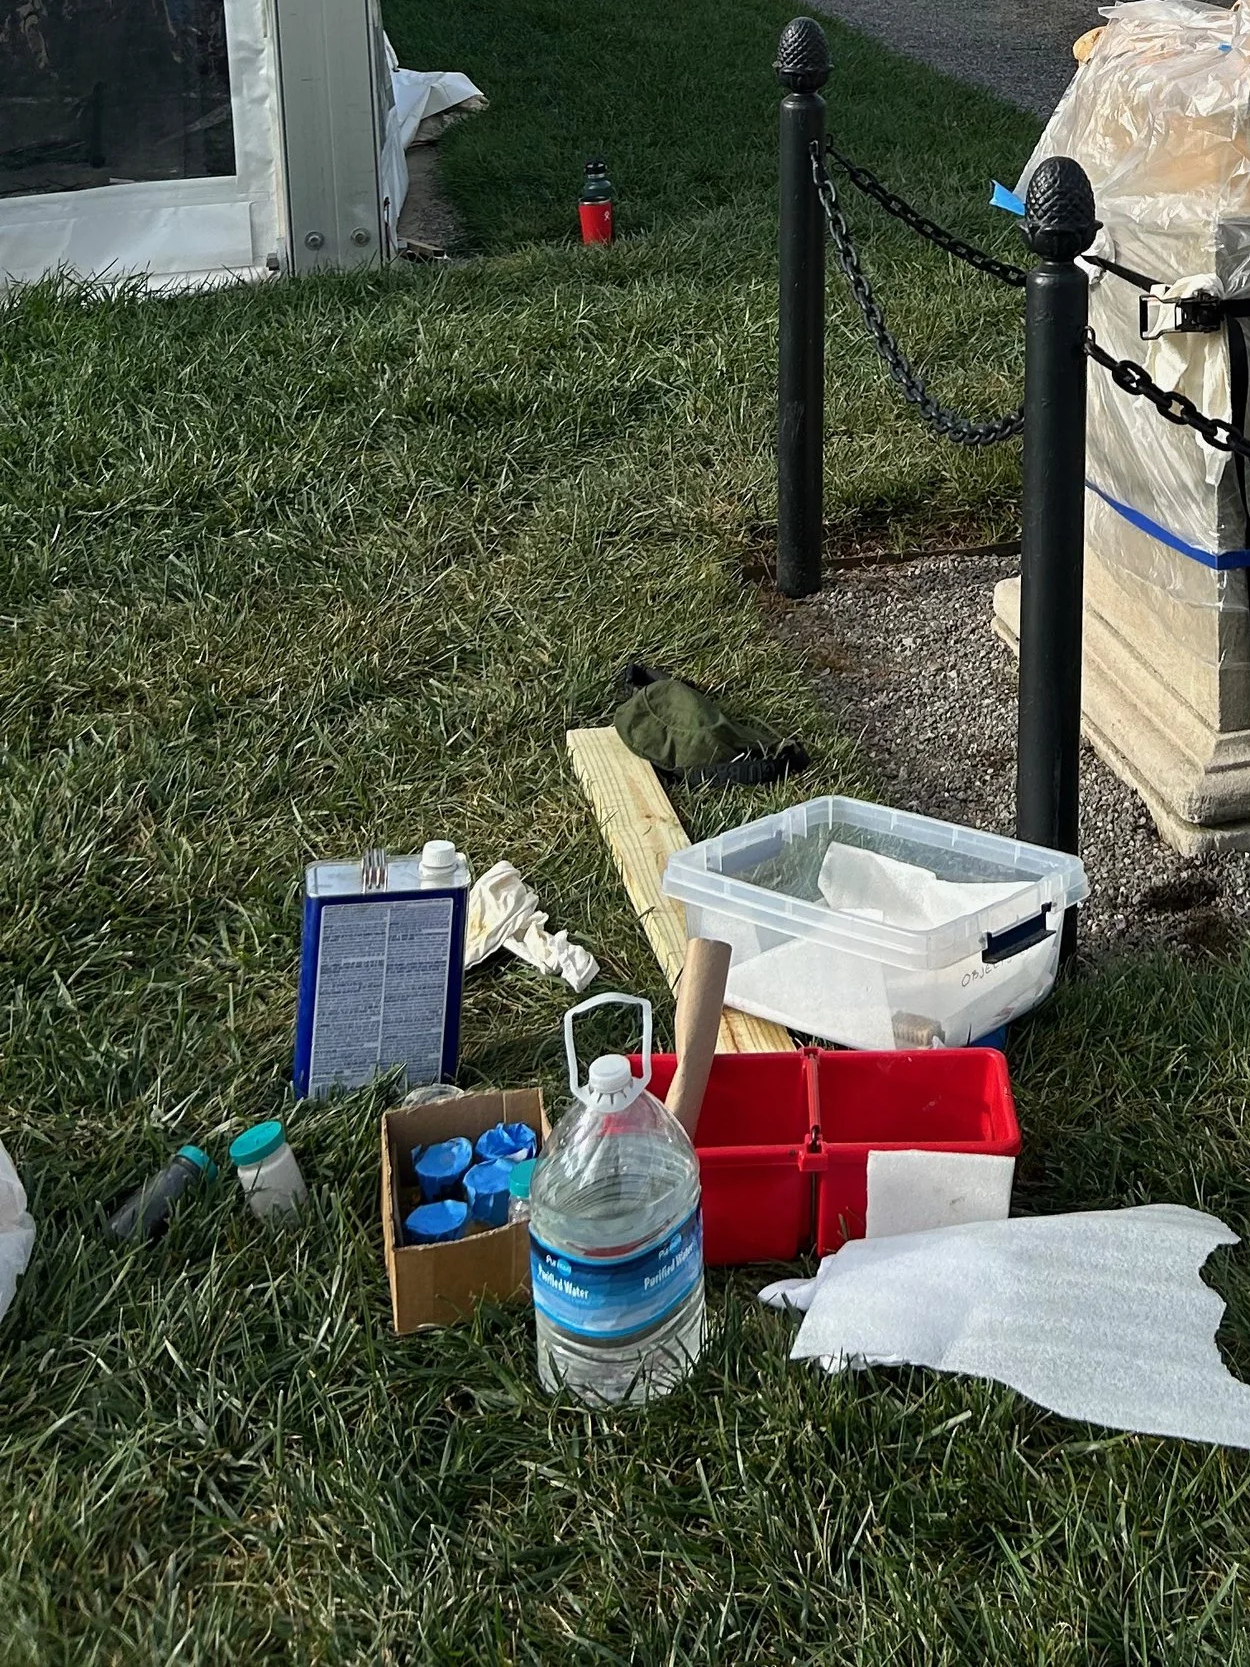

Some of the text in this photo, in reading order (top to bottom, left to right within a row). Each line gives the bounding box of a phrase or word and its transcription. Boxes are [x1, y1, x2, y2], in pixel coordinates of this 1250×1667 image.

[537, 1263, 564, 1292] Purified
[564, 1279, 589, 1300] Water
[644, 1258, 675, 1291] Purified
